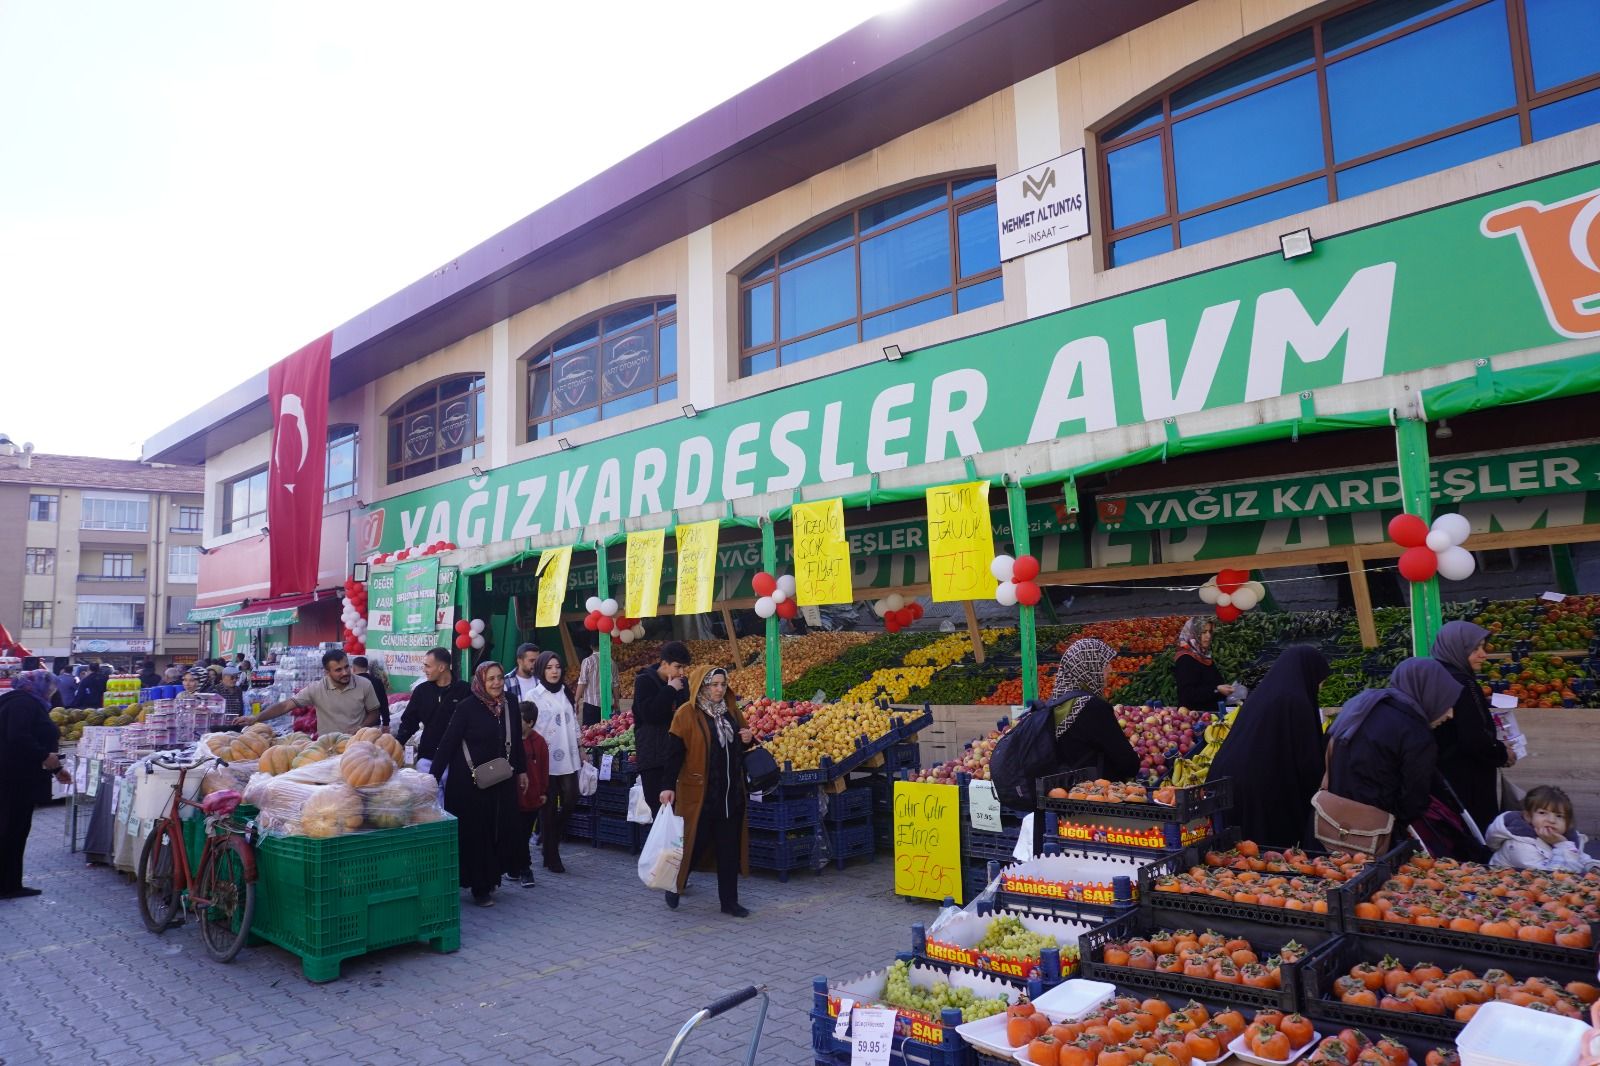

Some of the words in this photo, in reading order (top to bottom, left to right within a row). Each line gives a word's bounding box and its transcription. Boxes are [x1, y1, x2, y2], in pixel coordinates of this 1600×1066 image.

[1002, 210, 1035, 235] MEHMET
[1037, 194, 1082, 222] ALTUNTAŞ
[1026, 261, 1397, 444] AVM
[1135, 488, 1261, 525] YAĞIZ
[976, 812, 993, 821] 37.95
[896, 821, 939, 854] Elma
[1058, 826, 1092, 840] RIGÖL
[1107, 832, 1167, 848] SARIGÖL
[1007, 880, 1067, 897] SARIGÖL
[926, 943, 975, 966] ARIGÖL
[858, 1040, 880, 1053] 59.95
